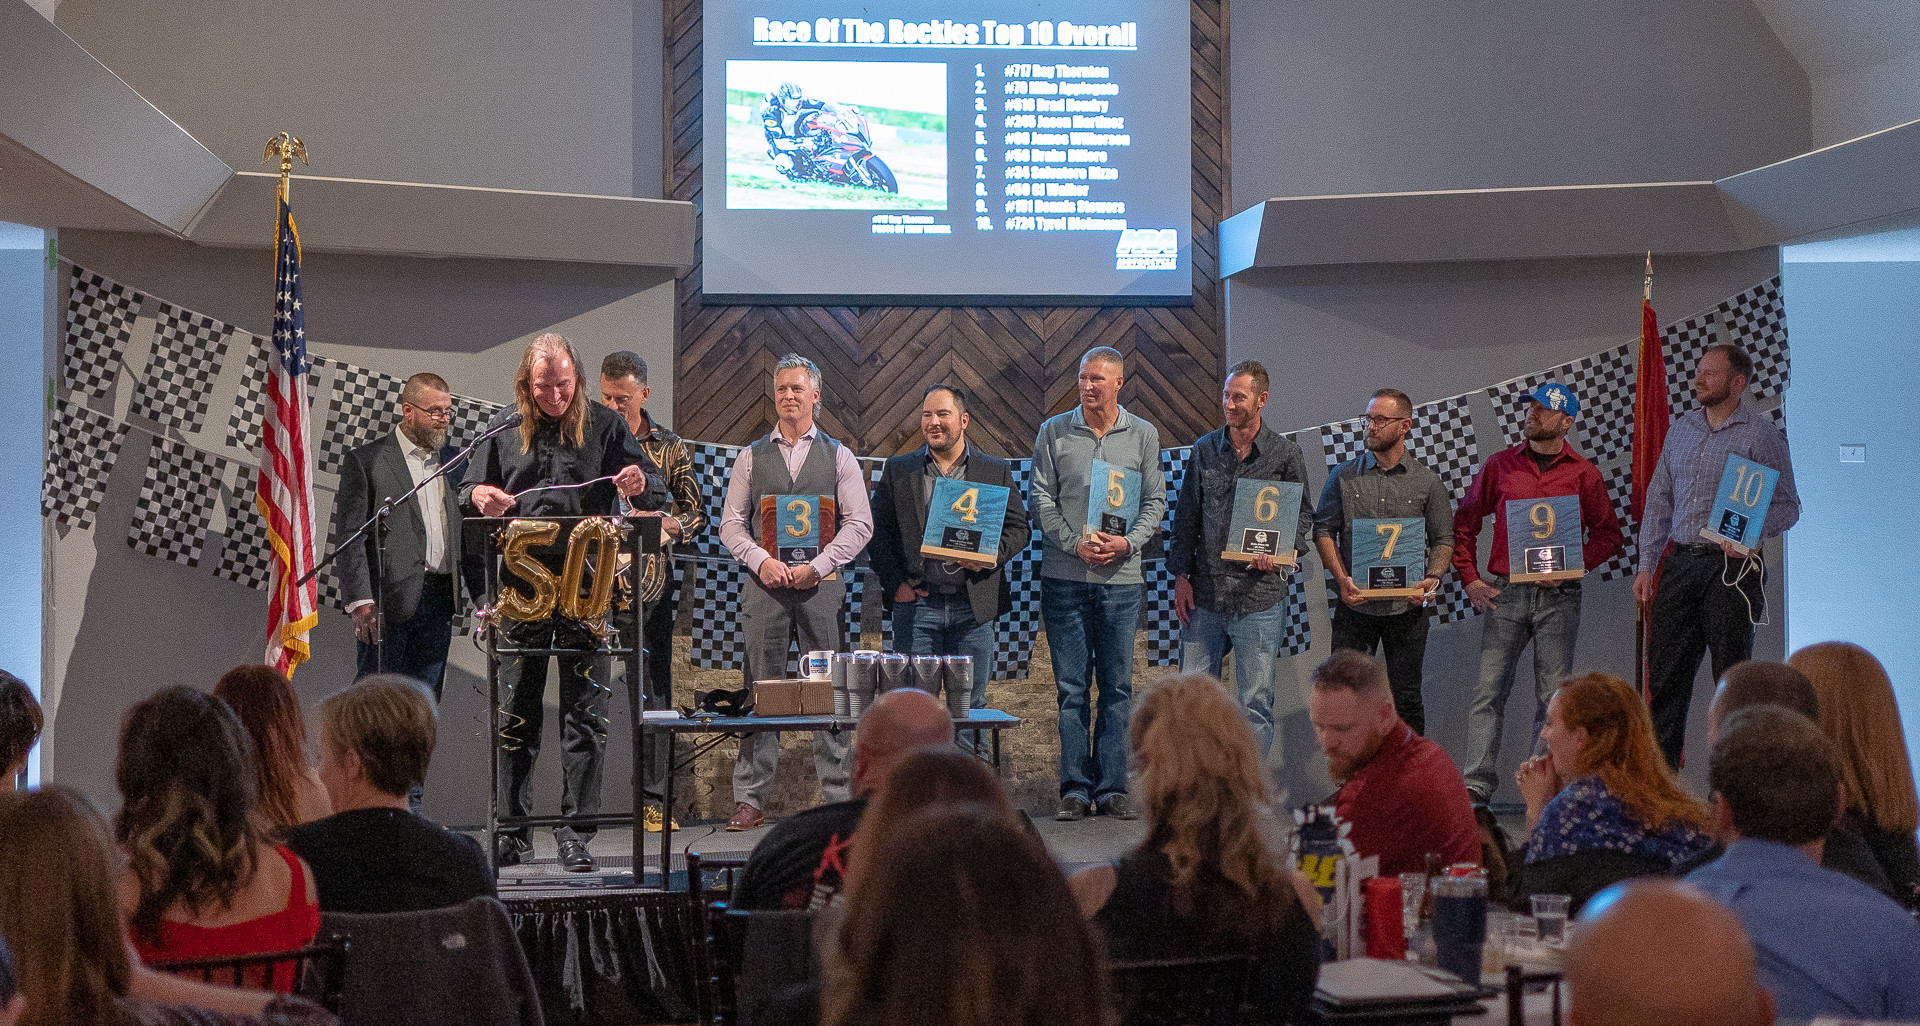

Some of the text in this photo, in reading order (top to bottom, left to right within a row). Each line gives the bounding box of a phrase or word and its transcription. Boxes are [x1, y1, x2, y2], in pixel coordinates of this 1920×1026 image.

[753, 17, 1136, 46] Race Of The Rockies Top 10 Overall
[975, 81, 986, 94] 2.
[975, 98, 987, 111] 3.
[975, 114, 987, 127] 4.
[976, 131, 987, 144] 5.
[975, 165, 985, 179] 7.
[1107, 469, 1125, 508] 5
[1729, 464, 1764, 507] 10
[785, 499, 812, 538] 3
[951, 487, 979, 523] 4
[1254, 486, 1280, 522] 6
[1530, 502, 1556, 540] 9
[1376, 523, 1403, 560] 7
[498, 516, 621, 622] 50
